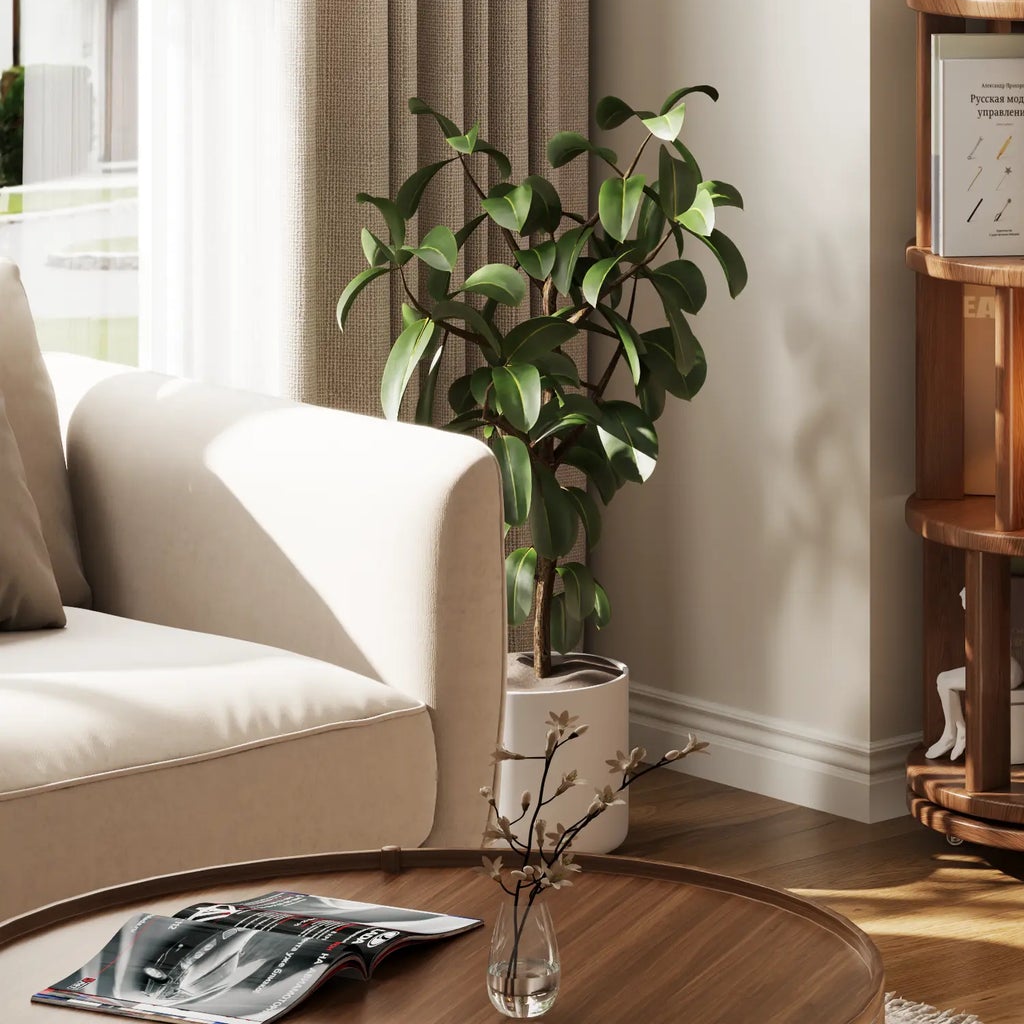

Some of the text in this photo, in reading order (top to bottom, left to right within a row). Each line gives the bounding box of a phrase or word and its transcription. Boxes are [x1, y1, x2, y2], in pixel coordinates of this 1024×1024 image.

[970, 94, 1005, 105] Русская
[278, 951, 294, 969] уже
[313, 952, 330, 965] НА
